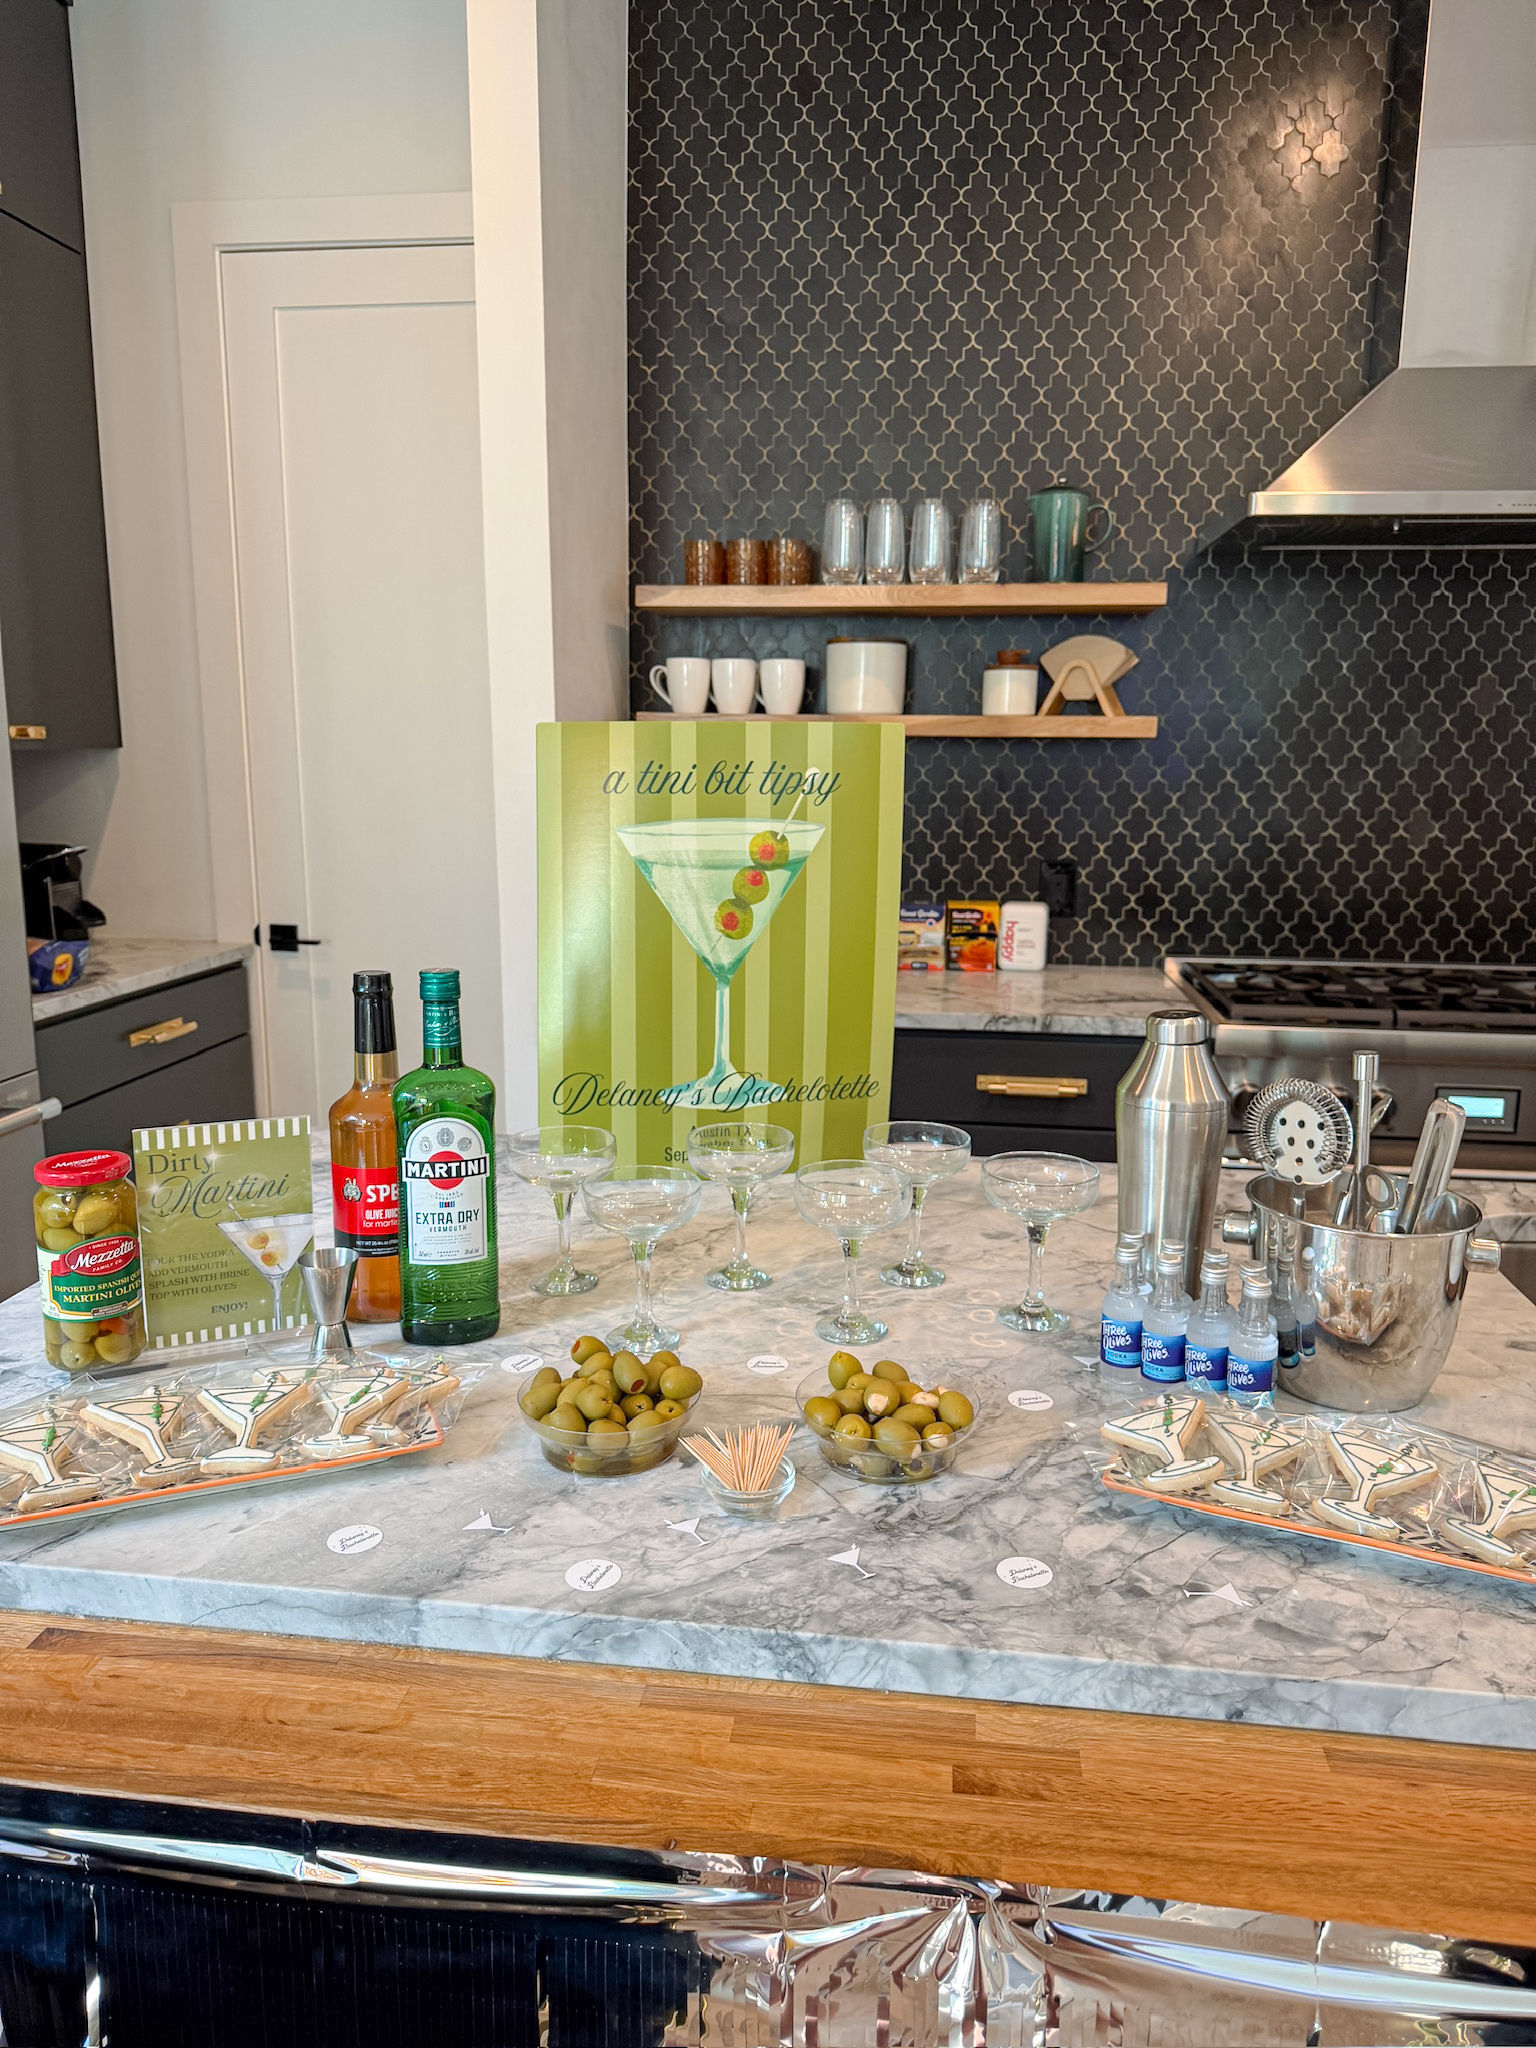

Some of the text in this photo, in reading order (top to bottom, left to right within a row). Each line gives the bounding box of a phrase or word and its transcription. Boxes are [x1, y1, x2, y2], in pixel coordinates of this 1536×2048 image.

[602, 759, 841, 806] a tini bit tipsy
[552, 1072, 705, 1115] Delaney's
[148, 1153, 214, 1175] Dirty
[407, 1158, 485, 1178] MARTINI
[151, 1172, 290, 1219] Martini
[365, 1209, 384, 1220] OLIVE
[415, 1208, 480, 1225] EXTRA DRY
[363, 1219, 374, 1228] for
[71, 1240, 134, 1270] Mezzetta
[176, 1253, 199, 1262] THE
[200, 1248, 235, 1259] VODKA
[92, 1262, 114, 1272] FAMILY
[148, 1261, 228, 1278] ADD VERMOUTH
[54, 1284, 96, 1293] IMPORTED
[97, 1276, 130, 1291] SPANISH
[149, 1268, 250, 1290] SPLASH WITH BRINE
[63, 1290, 113, 1303] MARTINI
[149, 1282, 237, 1301] TOP WITH OLIVES
[211, 1301, 249, 1314] ENJOY!
